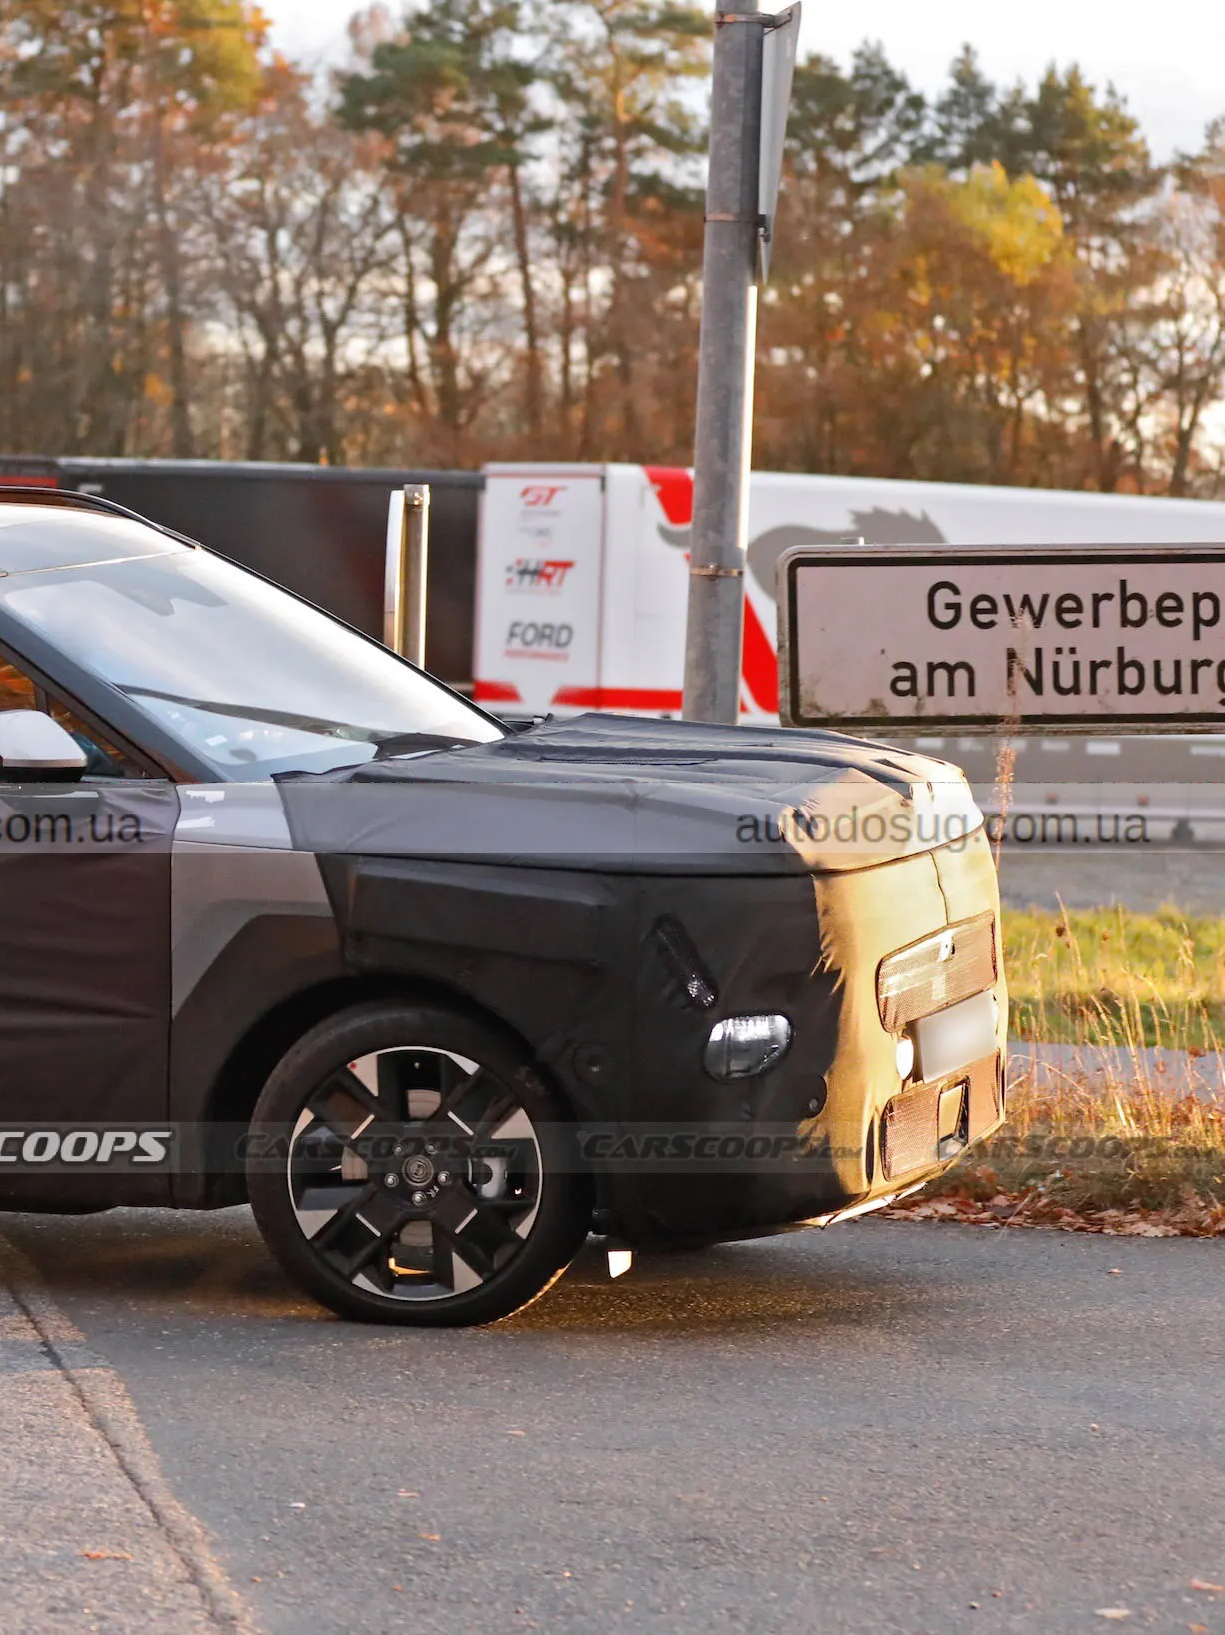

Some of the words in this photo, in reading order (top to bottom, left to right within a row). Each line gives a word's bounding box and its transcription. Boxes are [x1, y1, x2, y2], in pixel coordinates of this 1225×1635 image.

[927, 579, 1221, 641] Gewerbep
[506, 621, 574, 649] FORD
[890, 659, 975, 698] am
